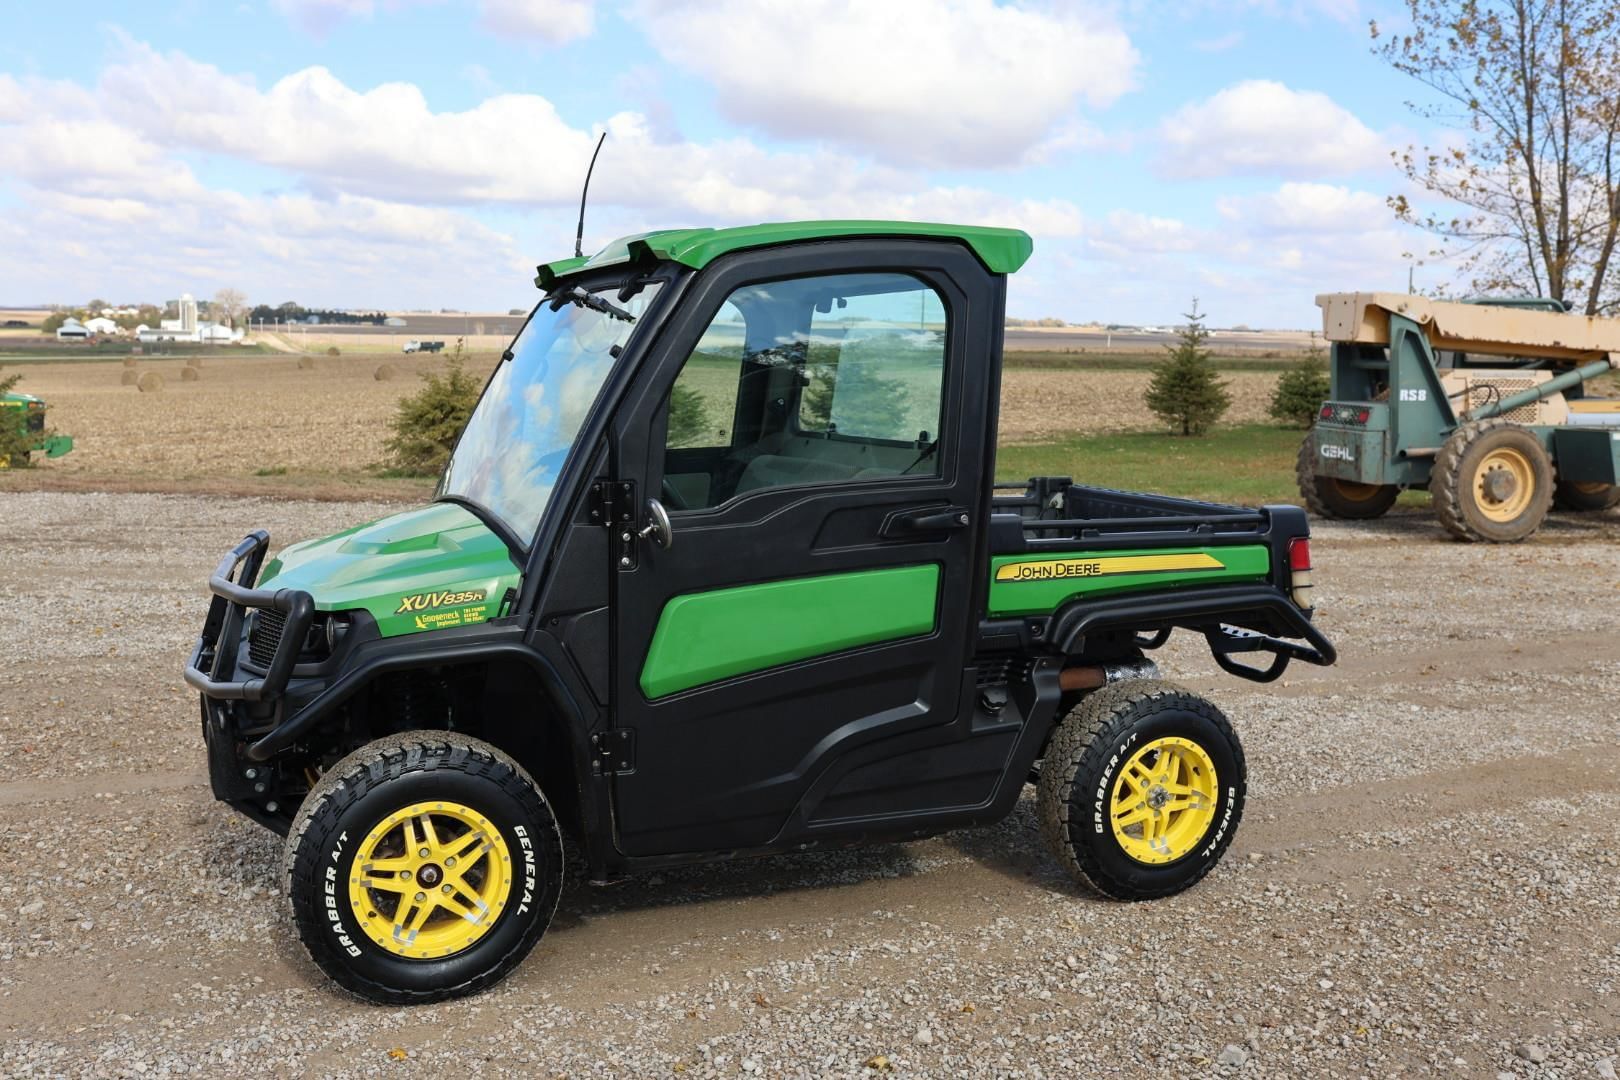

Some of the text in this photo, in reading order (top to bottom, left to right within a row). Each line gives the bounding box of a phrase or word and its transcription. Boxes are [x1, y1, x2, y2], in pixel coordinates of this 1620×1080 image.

[1400, 389, 1427, 401] RS8
[1320, 444, 1354, 461] GEHL
[1014, 563, 1100, 579] JOHN DEERE
[422, 610, 460, 623] Gooseneck
[1094, 733, 1137, 833] GRABBER A/T
[1202, 787, 1235, 857] GENERAL
[514, 825, 536, 915] GENERAL
[324, 831, 362, 958] GRABBER A/T
